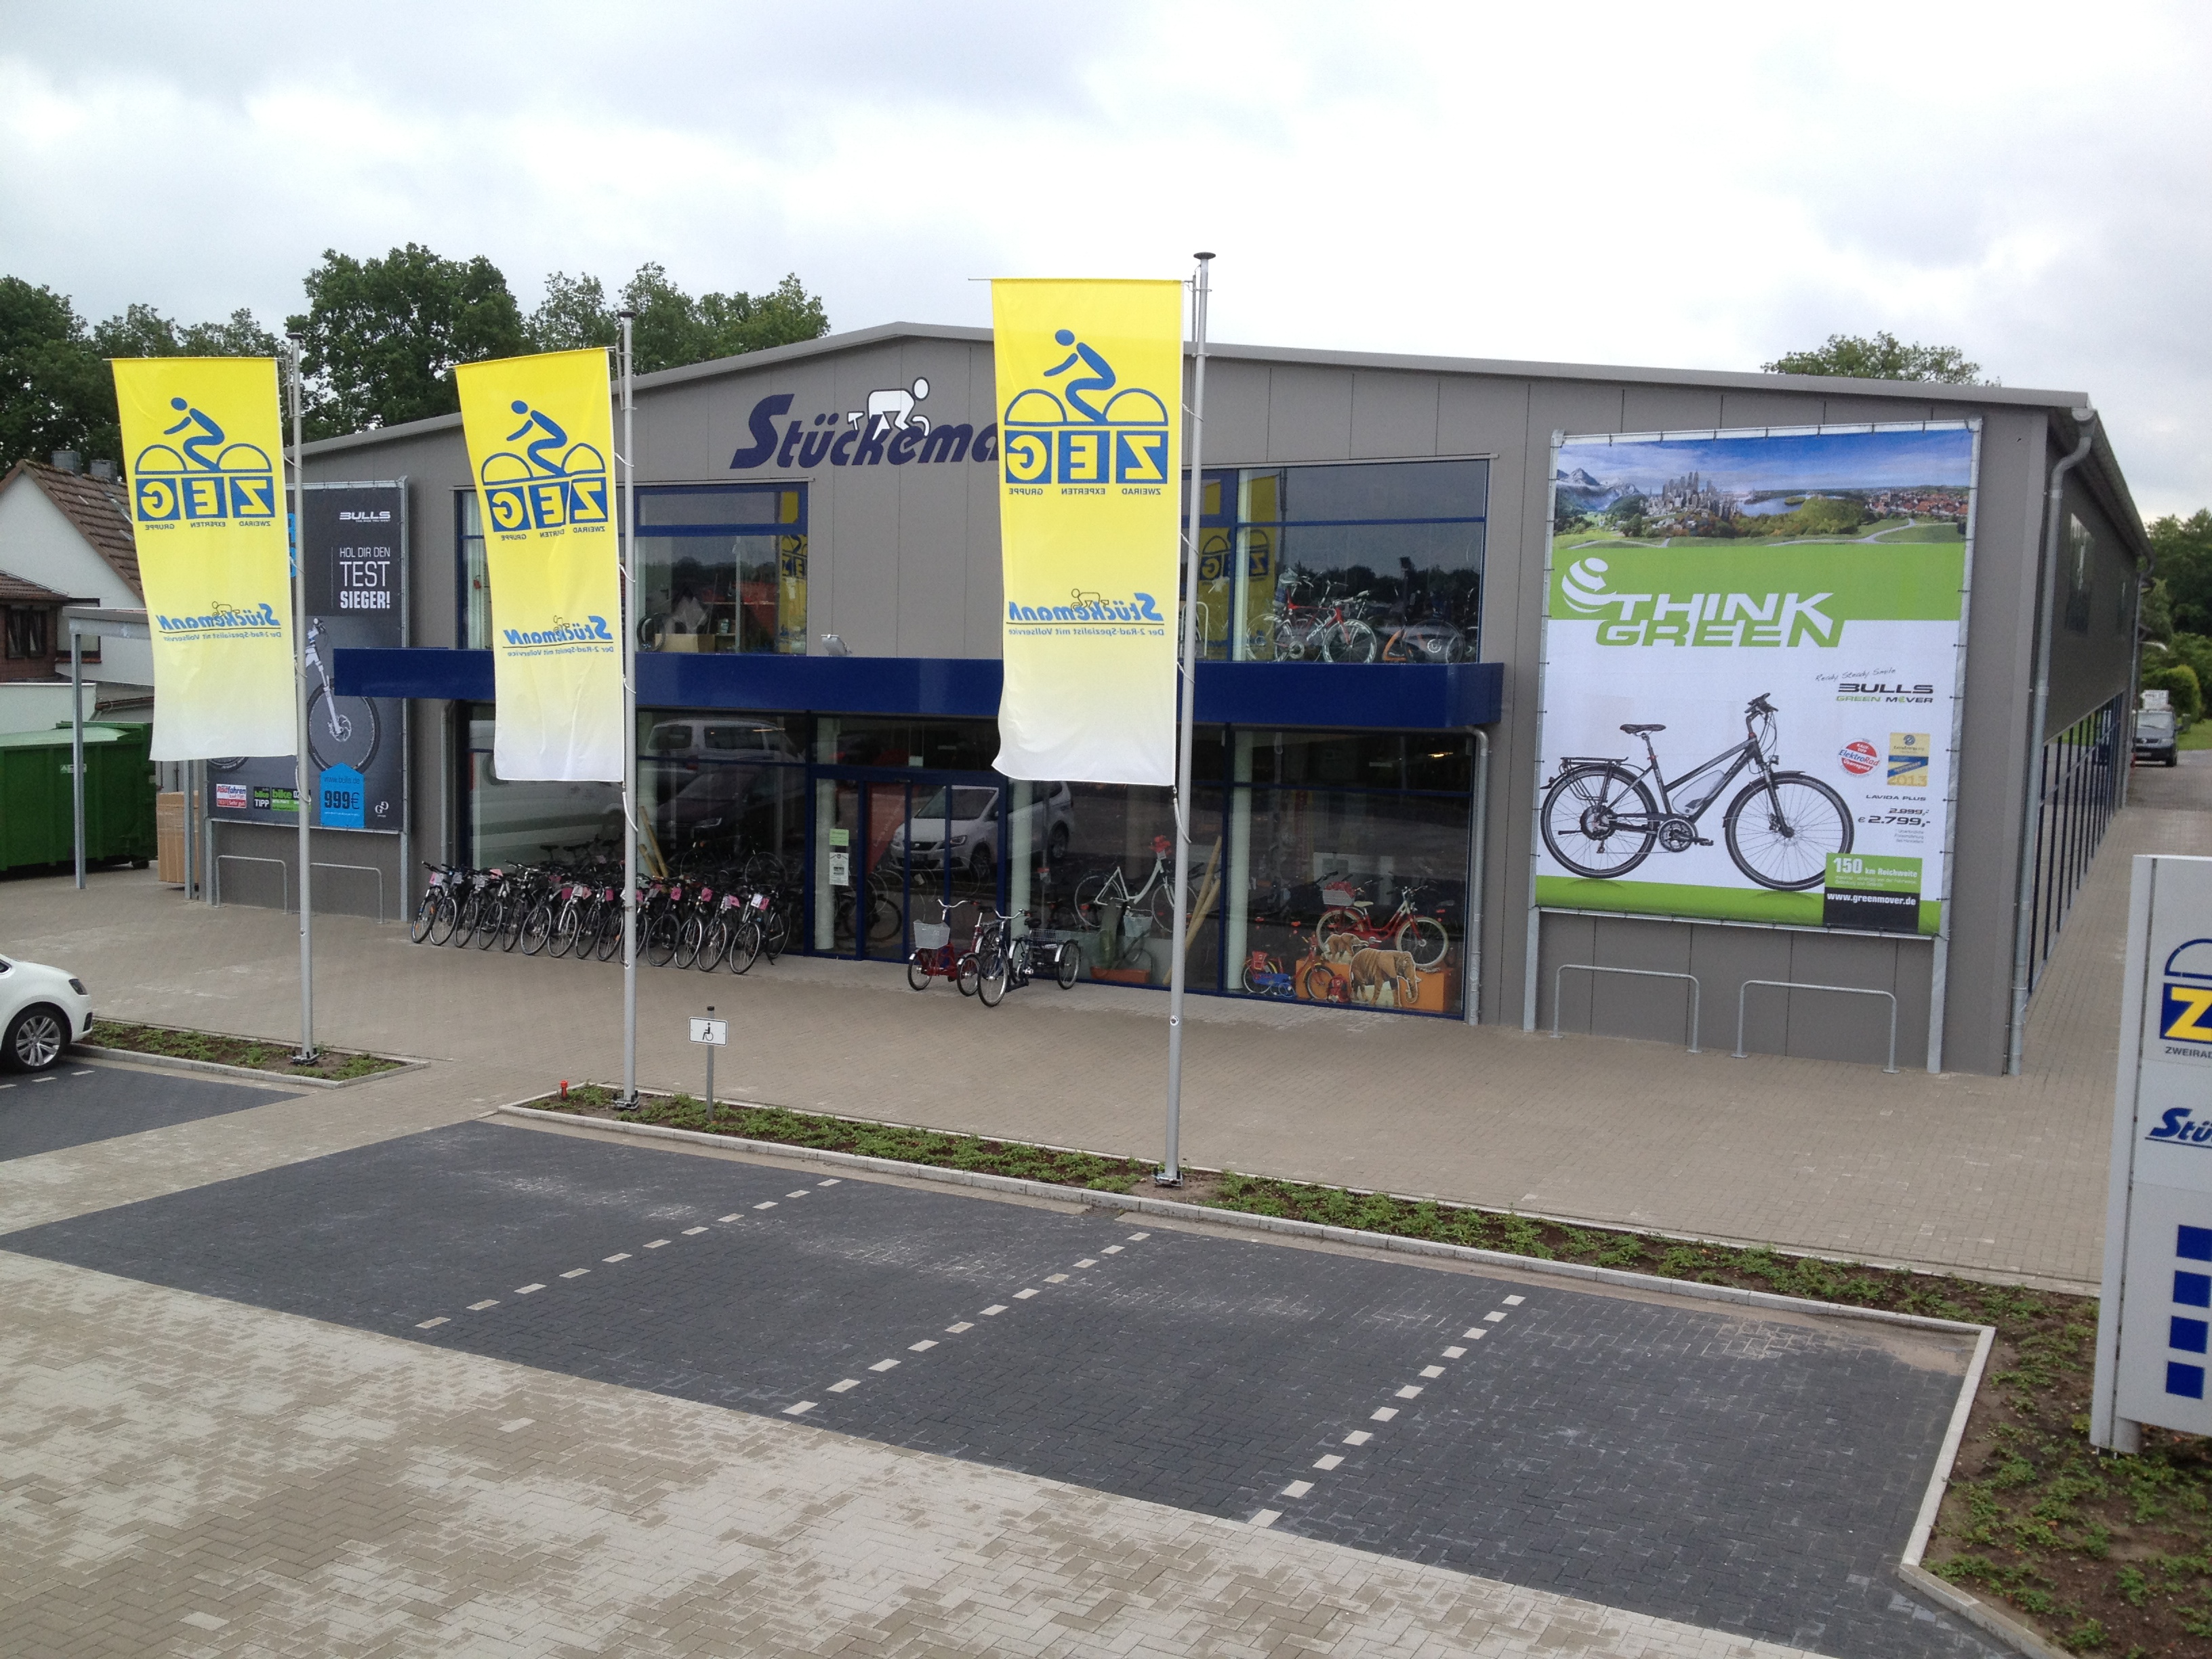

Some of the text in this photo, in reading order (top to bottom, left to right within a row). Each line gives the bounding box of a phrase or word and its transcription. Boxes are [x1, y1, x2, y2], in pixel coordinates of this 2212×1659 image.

[729, 394, 998, 469] Stückema
[340, 511, 391, 520] BULLS
[340, 546, 390, 558] HOL DIR DEN
[340, 560, 390, 587] TEST
[340, 591, 390, 609] SIEGER!
[1610, 592, 1834, 621] THINK
[1595, 619, 1845, 647] GREEN
[1815, 666, 1896, 682] Ready Steady Smile
[1838, 682, 1934, 694] BULLS
[1839, 749, 1881, 766] ElektroRad
[254, 798, 270, 807] TIPP
[1833, 857, 1918, 878] 150 km Reichweite
[1826, 893, 1917, 906] www.greenmover.de
